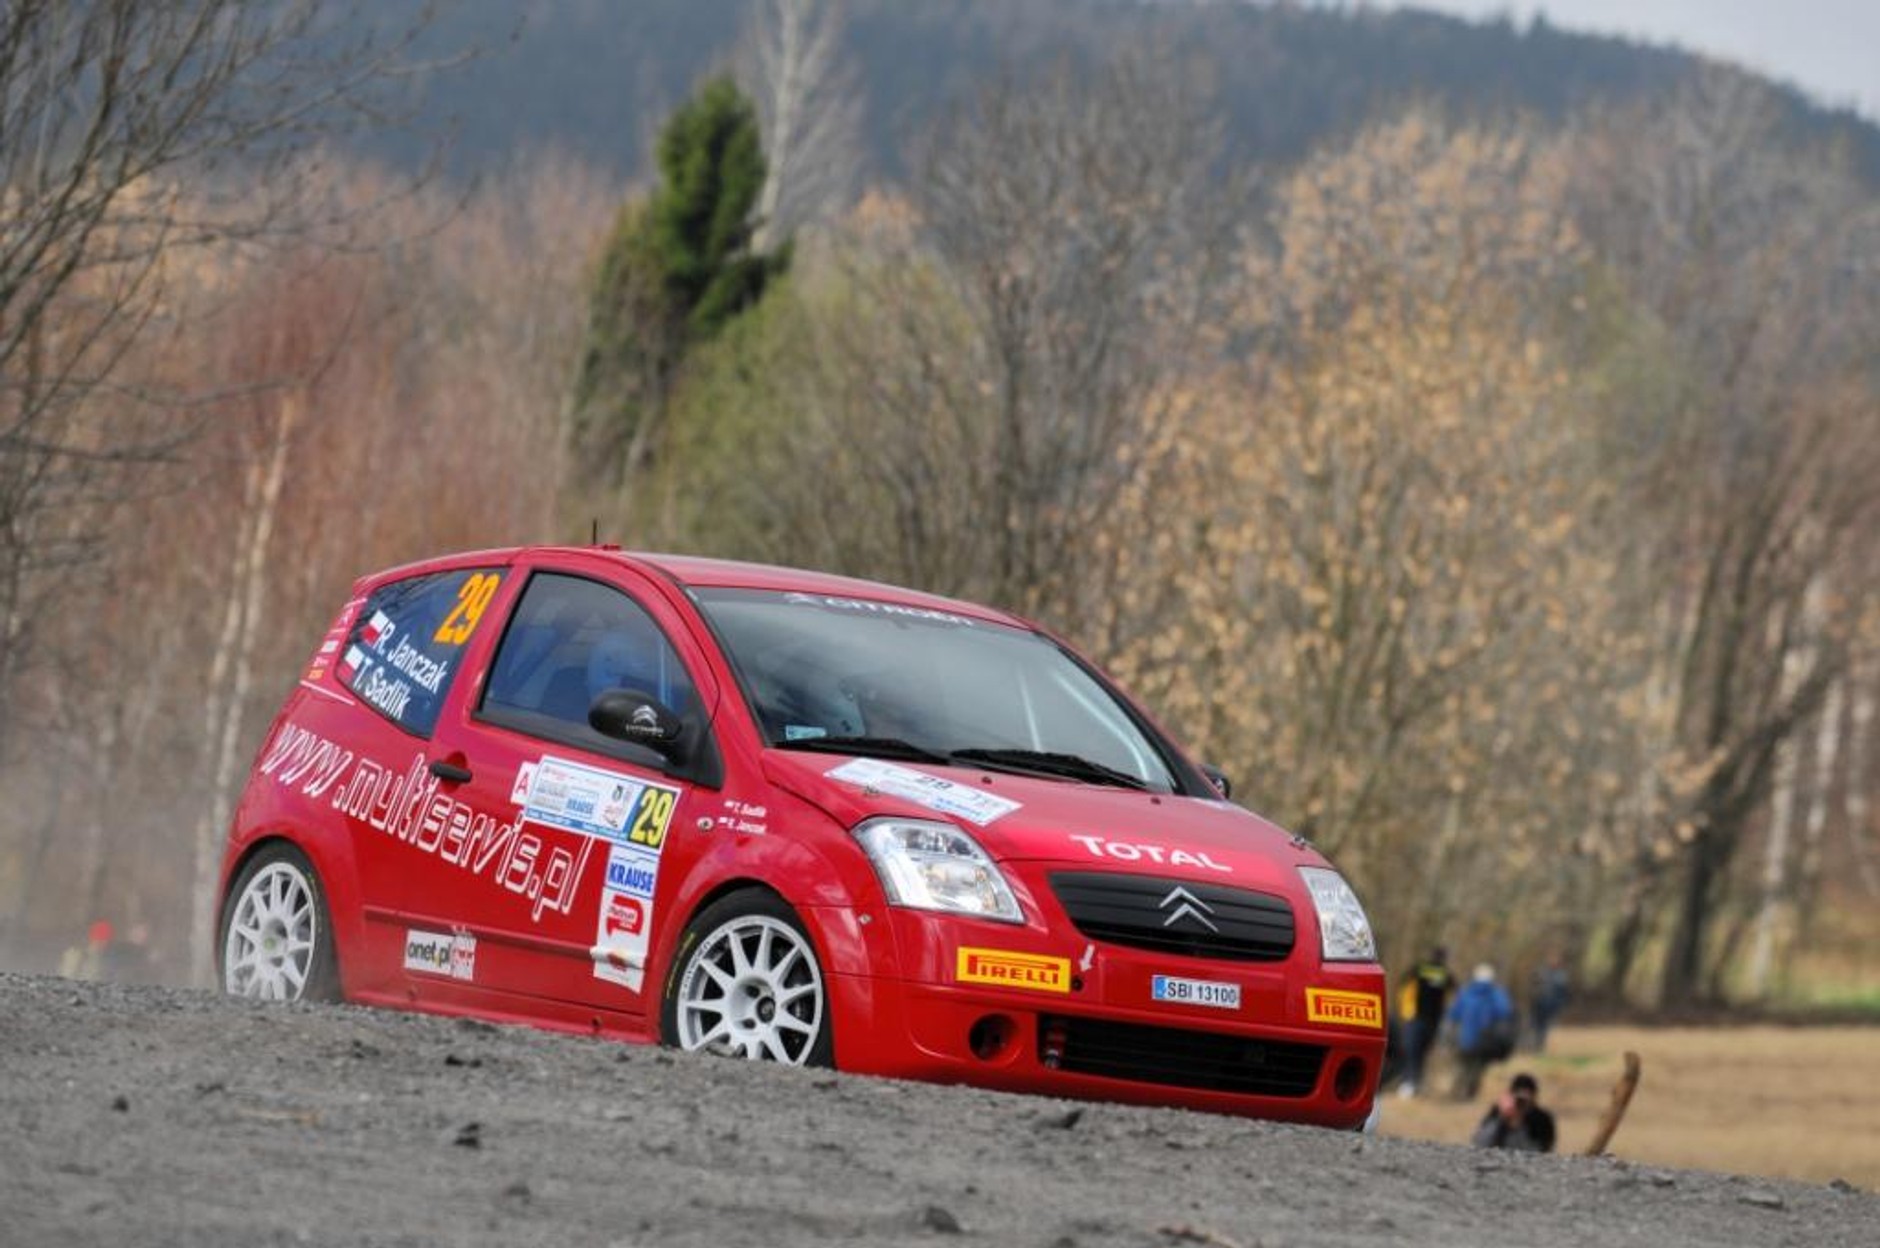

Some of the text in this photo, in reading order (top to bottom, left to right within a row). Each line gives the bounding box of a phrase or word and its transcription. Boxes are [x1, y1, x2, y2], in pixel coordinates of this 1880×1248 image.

[433, 572, 500, 645] 29
[386, 633, 448, 695] Janczak
[365, 666, 411, 720] Sadlik
[629, 788, 673, 847] 29
[1069, 834, 1233, 873] TOTAL
[608, 861, 655, 893] KRAUSE
[966, 954, 1060, 985] PIRELLI
[1167, 982, 1237, 1004] SBI 13100
[1315, 995, 1377, 1020] PIRELLI
